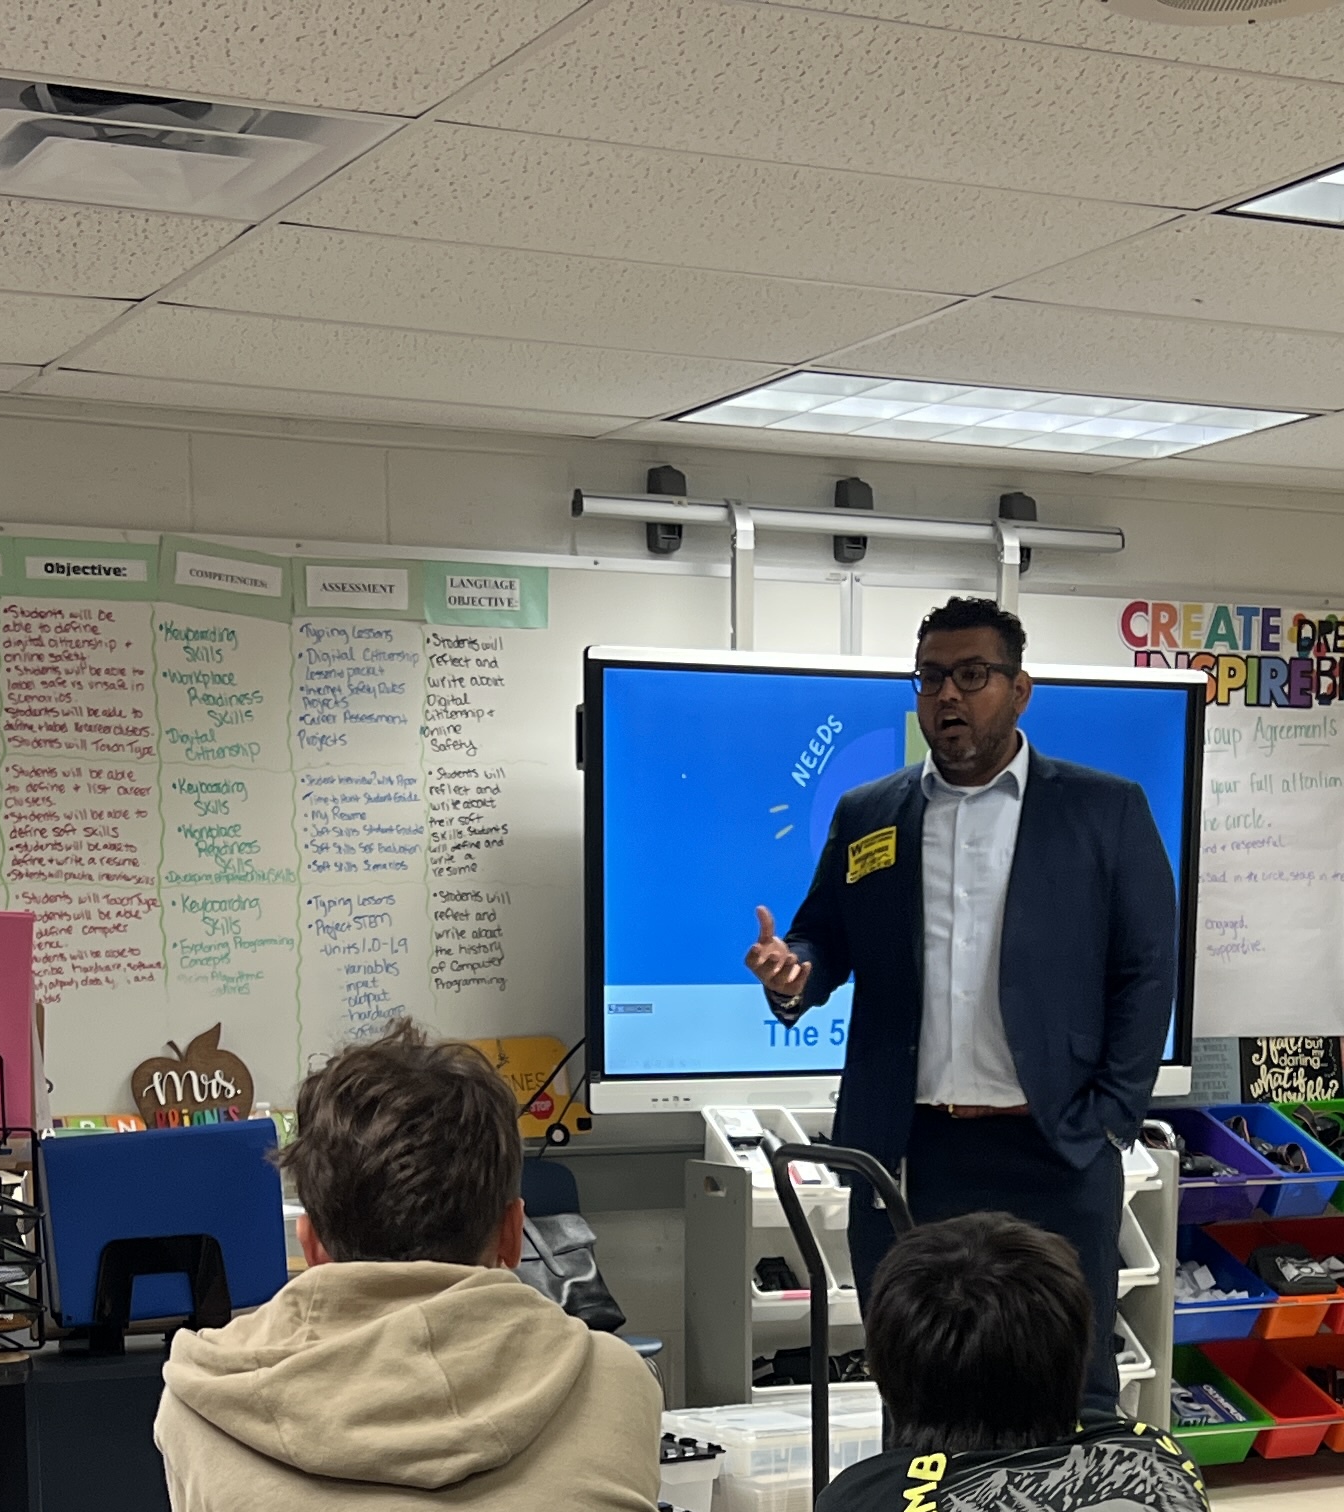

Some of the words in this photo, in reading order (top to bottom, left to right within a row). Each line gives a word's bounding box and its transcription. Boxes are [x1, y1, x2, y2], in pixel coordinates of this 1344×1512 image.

[44, 562, 127, 577] Objective:
[320, 582, 395, 594] ASSESSMENT
[450, 578, 516, 590] LANGUAGE
[448, 596, 518, 607] OBJECTIVE:
[1121, 601, 1281, 651] CREATE
[476, 659, 498, 668] and
[428, 678, 466, 688] write
[1256, 716, 1337, 757] Agreements
[791, 714, 843, 787] NEEDS
[477, 785, 501, 795] and
[1211, 777, 1238, 806] your
[1250, 774, 1273, 794] full
[1282, 772, 1342, 792] attention
[182, 894, 261, 920] Keyboarding
[313, 895, 352, 917] Typing
[476, 909, 496, 920] and
[315, 919, 351, 940] Project
[459, 941, 503, 958] history
[764, 1019, 818, 1047] The
[830, 1019, 845, 1046] 5
[1305, 1037, 1323, 1049] but
[143, 1069, 242, 1105] Mrs.
[1250, 1064, 1293, 1098] what
[1293, 1068, 1307, 1093] if
[1306, 1076, 1339, 1101] fly?
[530, 1101, 552, 1112] STOP
